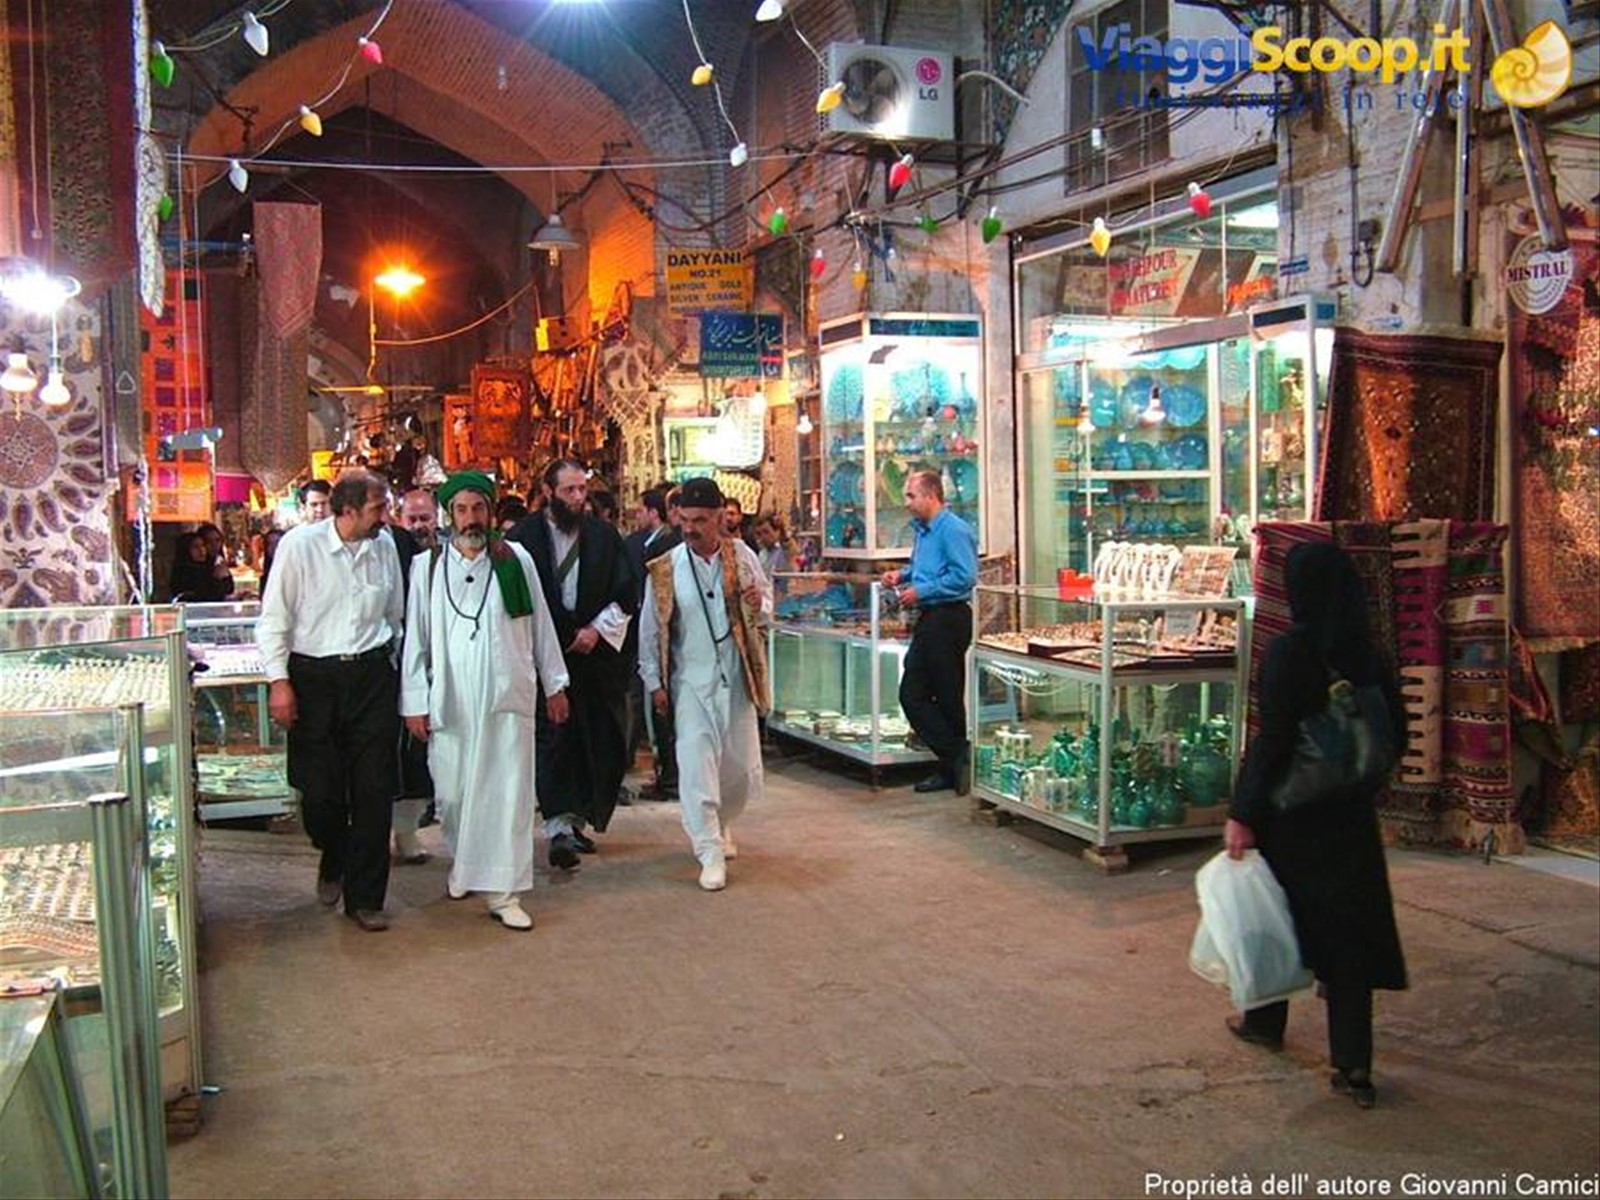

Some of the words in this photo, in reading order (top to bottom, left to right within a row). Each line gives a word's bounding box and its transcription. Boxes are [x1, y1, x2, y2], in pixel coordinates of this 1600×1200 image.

[918, 88, 939, 100] LG
[667, 252, 742, 267] DAYYANI
[1507, 261, 1569, 282] MISTRAL
